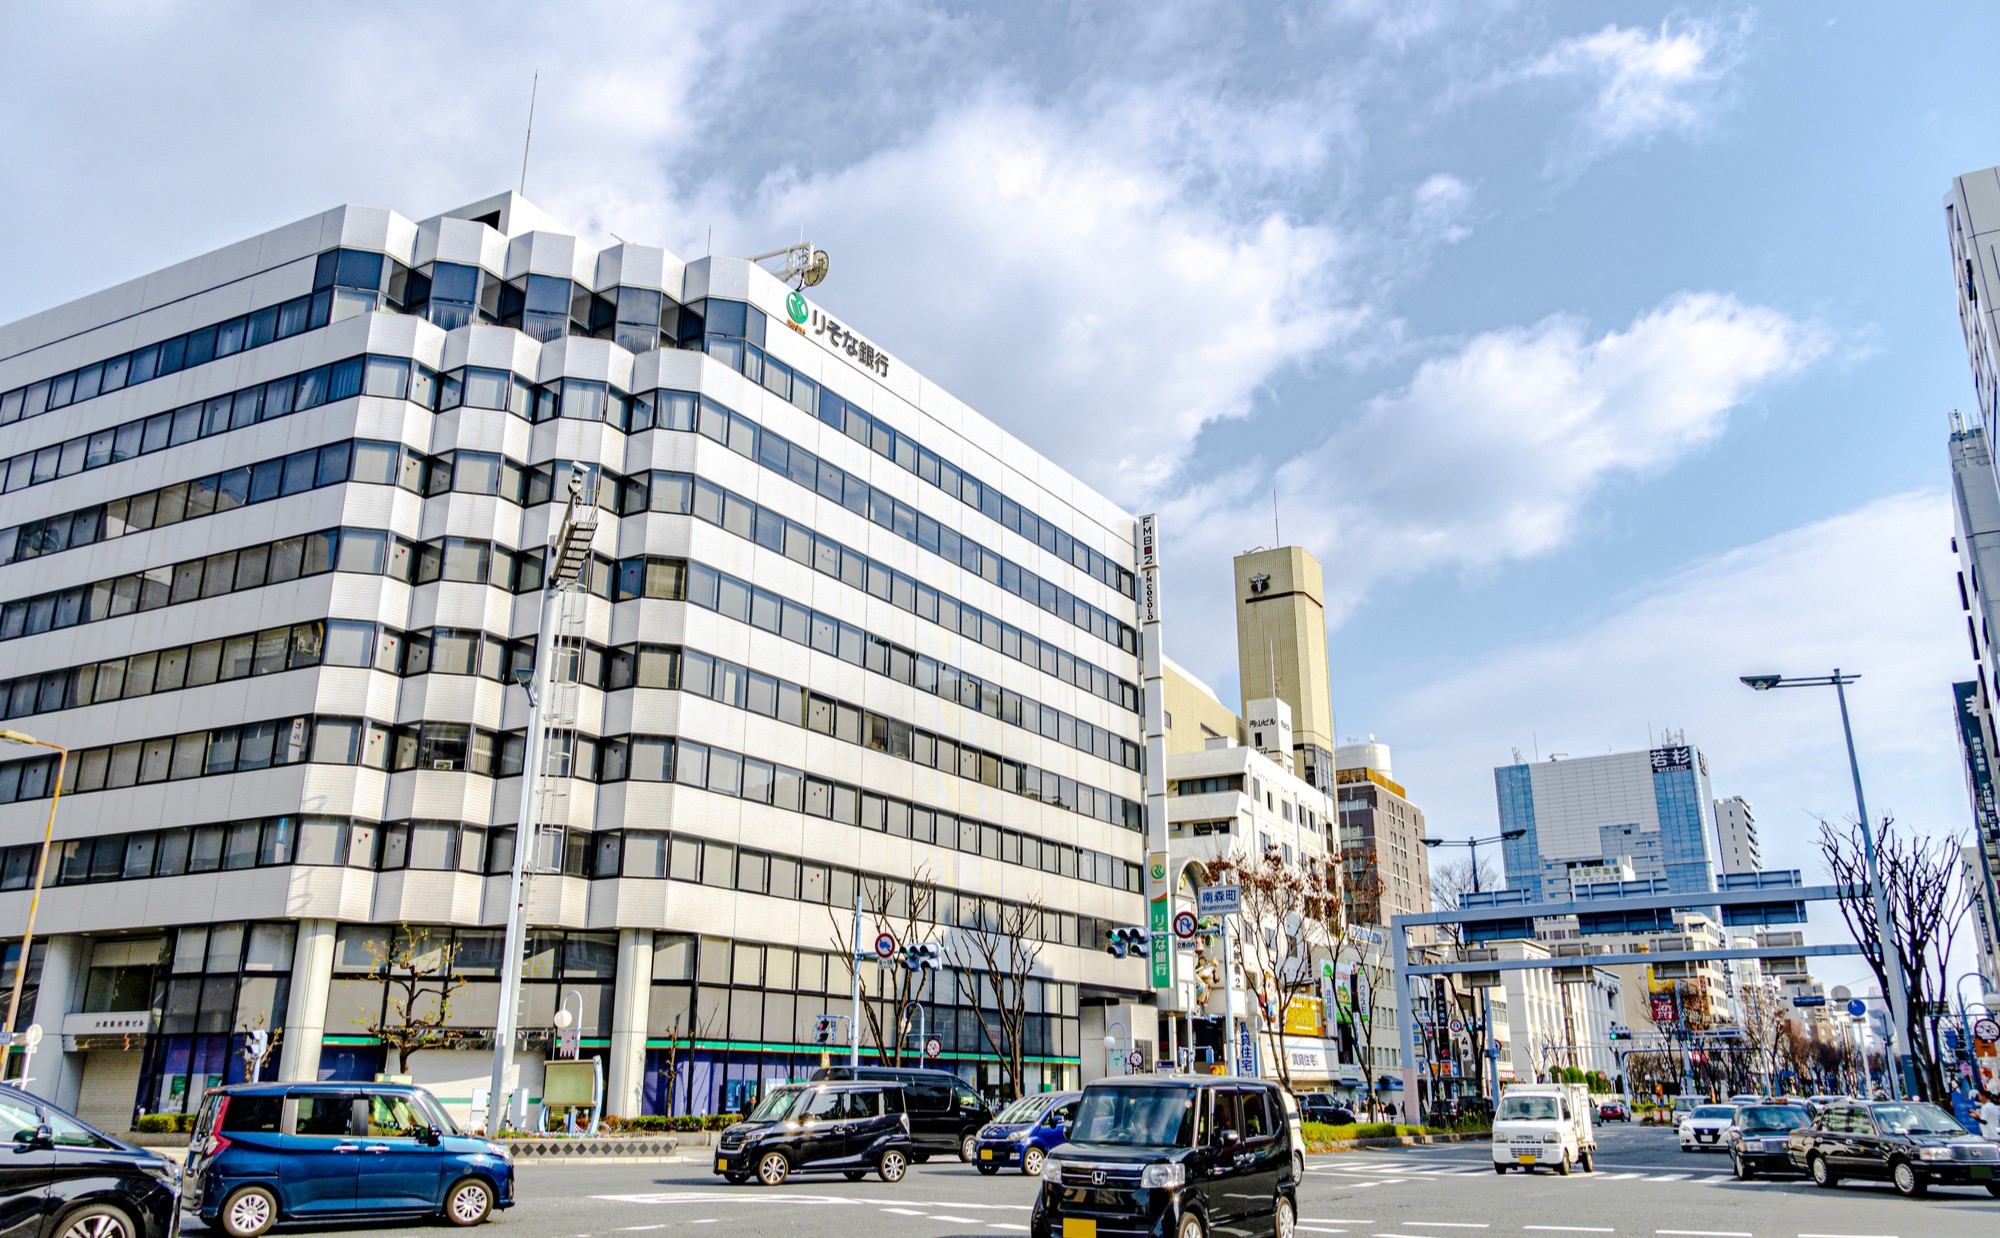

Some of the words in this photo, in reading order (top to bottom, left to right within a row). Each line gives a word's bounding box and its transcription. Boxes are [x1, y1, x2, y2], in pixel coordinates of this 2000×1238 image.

[812, 309, 888, 378] りそな銀行
[1650, 747, 1690, 767] 若杉
[1202, 889, 1237, 903] 南森町
[1201, 903, 1238, 912] Minamimorimachi
